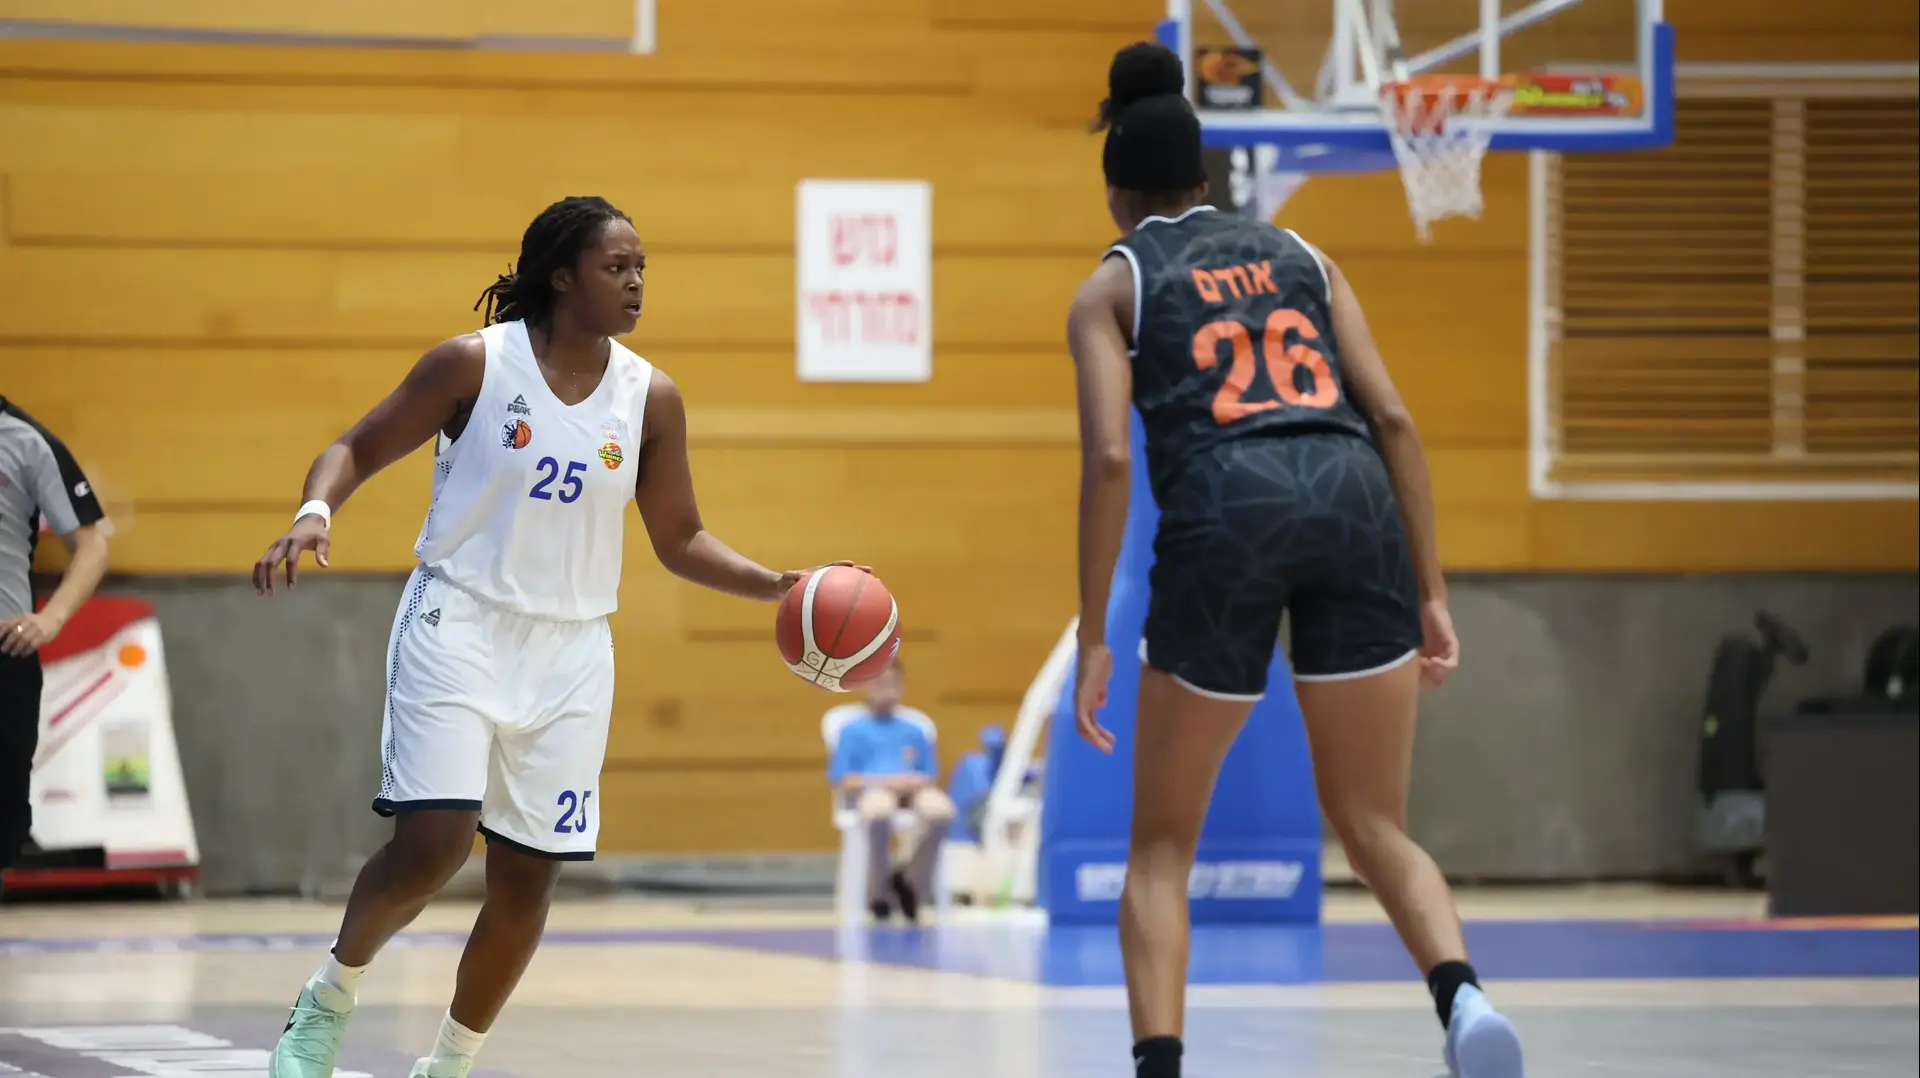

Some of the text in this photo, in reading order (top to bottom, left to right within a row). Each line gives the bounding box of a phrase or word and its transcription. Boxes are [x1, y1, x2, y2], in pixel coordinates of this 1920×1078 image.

[1190, 260, 1279, 302] אודם
[1192, 307, 1339, 426] 26
[507, 403, 531, 416] PEAK
[598, 449, 624, 462] Winner
[529, 456, 588, 503] 25
[554, 790, 592, 834] 25
